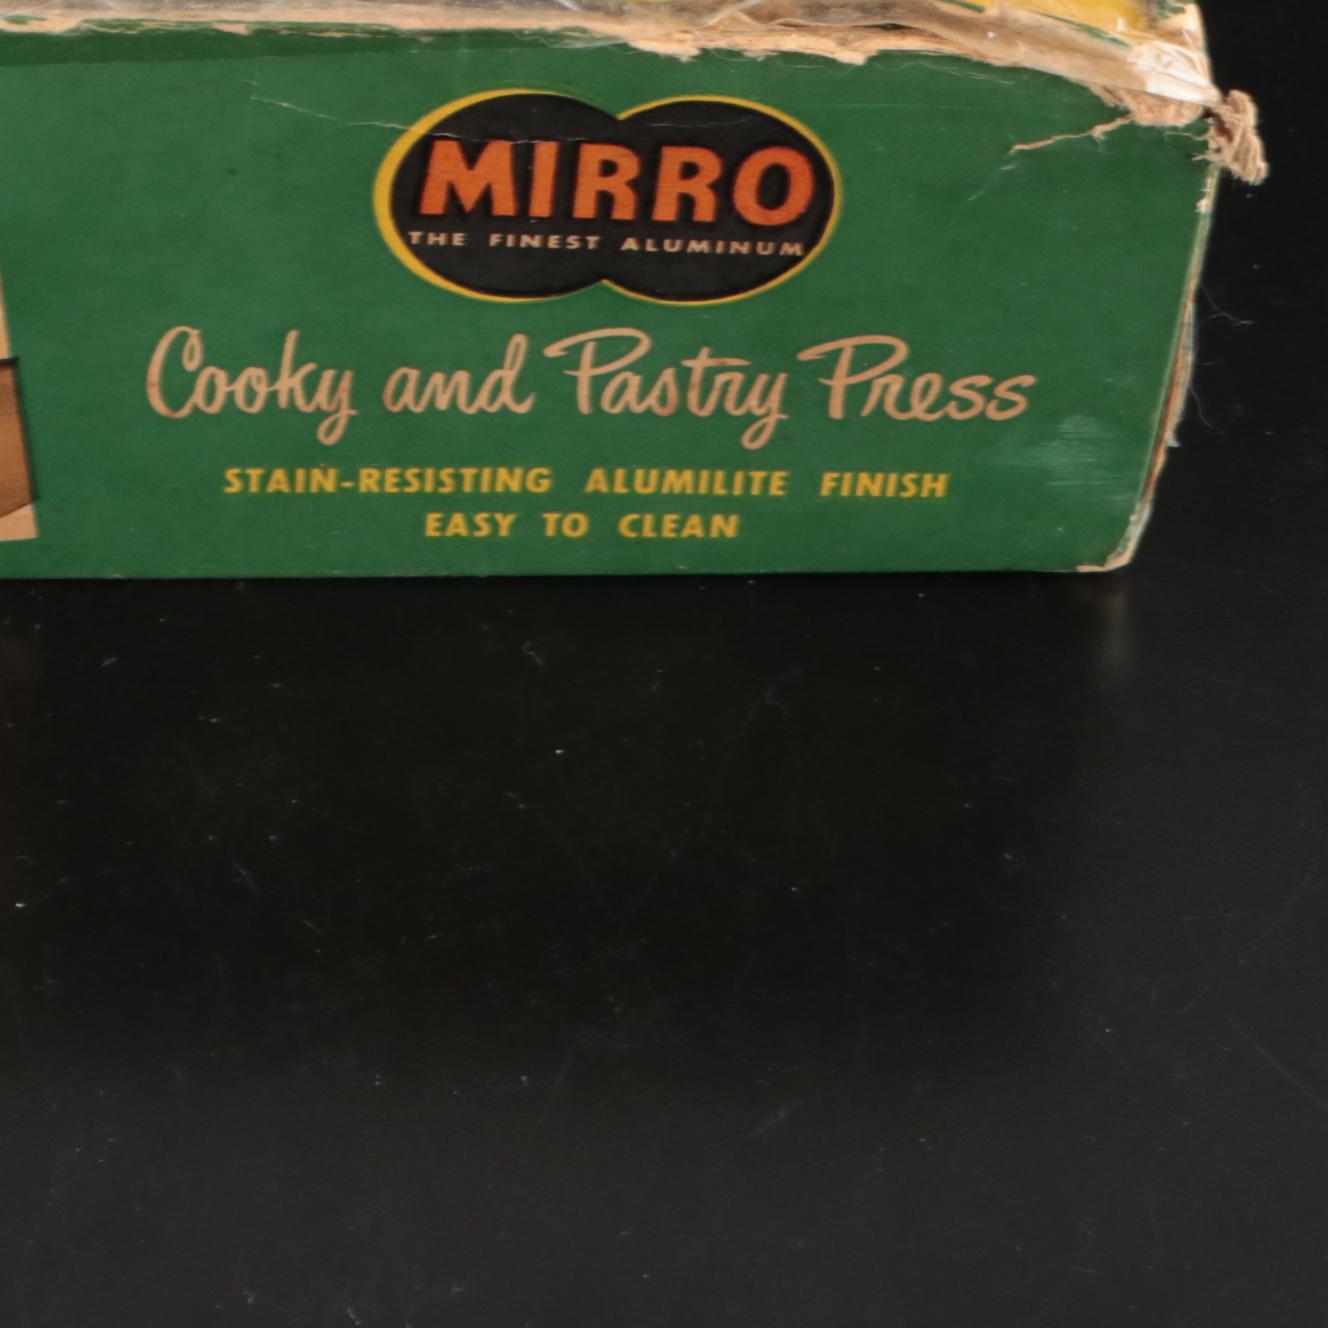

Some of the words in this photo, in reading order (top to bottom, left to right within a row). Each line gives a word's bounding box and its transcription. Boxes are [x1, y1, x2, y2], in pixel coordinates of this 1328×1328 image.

[418, 139, 815, 227] MIRRO
[408, 230, 467, 248] THE
[489, 233, 601, 251] FINEST
[622, 237, 804, 258] ALUMINUM
[145, 325, 358, 445] Cooky
[383, 334, 535, 415] and
[543, 327, 790, 451] Pastry
[798, 334, 1038, 422] Press
[224, 467, 553, 496] STAIN-RESISTING
[585, 469, 788, 498] ALUMILITE
[820, 472, 949, 500] FINISH
[425, 513, 517, 538] EASY
[544, 513, 588, 538] TO
[619, 514, 740, 539] CLEAN
